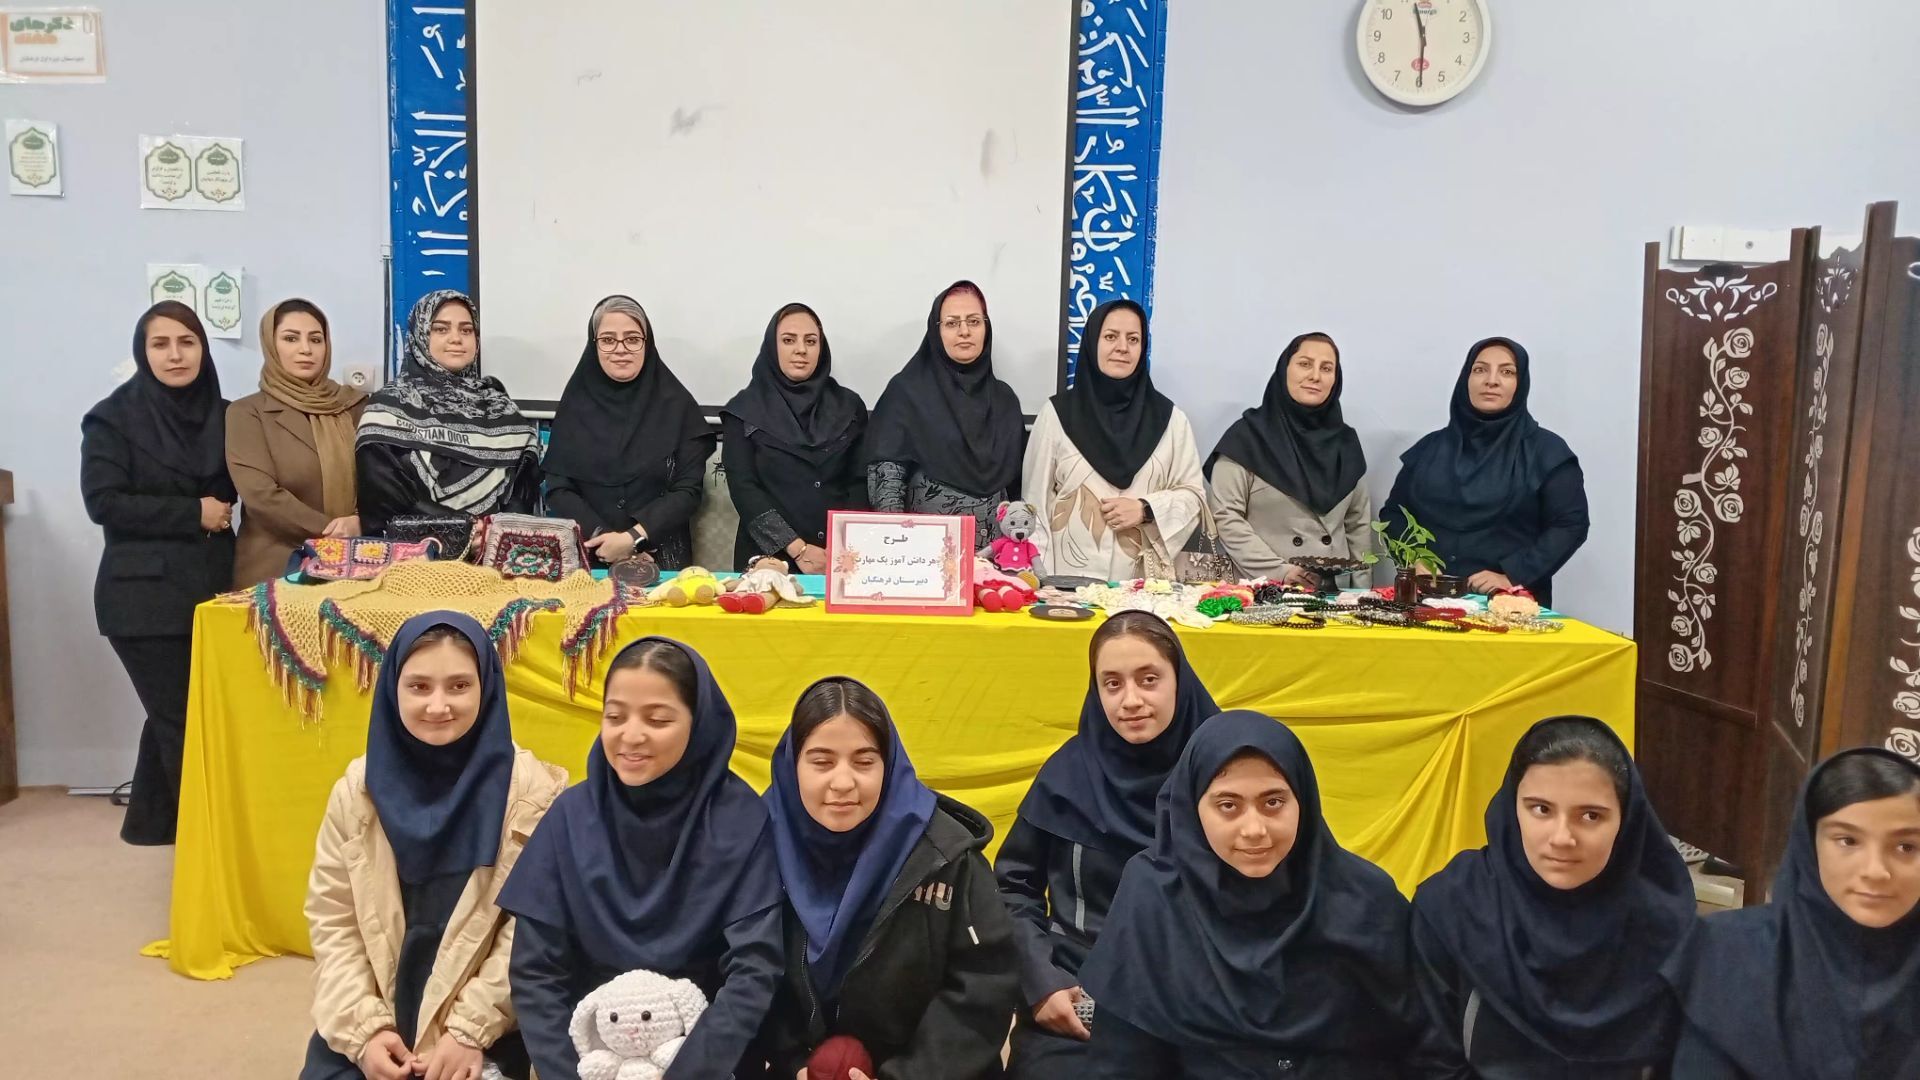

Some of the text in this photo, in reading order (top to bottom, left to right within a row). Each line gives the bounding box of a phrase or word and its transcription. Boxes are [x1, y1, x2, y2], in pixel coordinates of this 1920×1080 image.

[1380, 9, 1392, 20] 10
[1458, 11, 1467, 22] 2
[1373, 30, 1381, 42] 9
[1462, 32, 1470, 43] 3
[1377, 52, 1385, 63] 8
[1454, 55, 1462, 66] 4
[1394, 70, 1401, 82] 7
[1437, 71, 1445, 82] 5
[1415, 76, 1423, 88] 6
[447, 430, 471, 445] DIOR
[876, 555, 888, 565] یک
[890, 555, 905, 566] آموز
[907, 556, 926, 566] دانش
